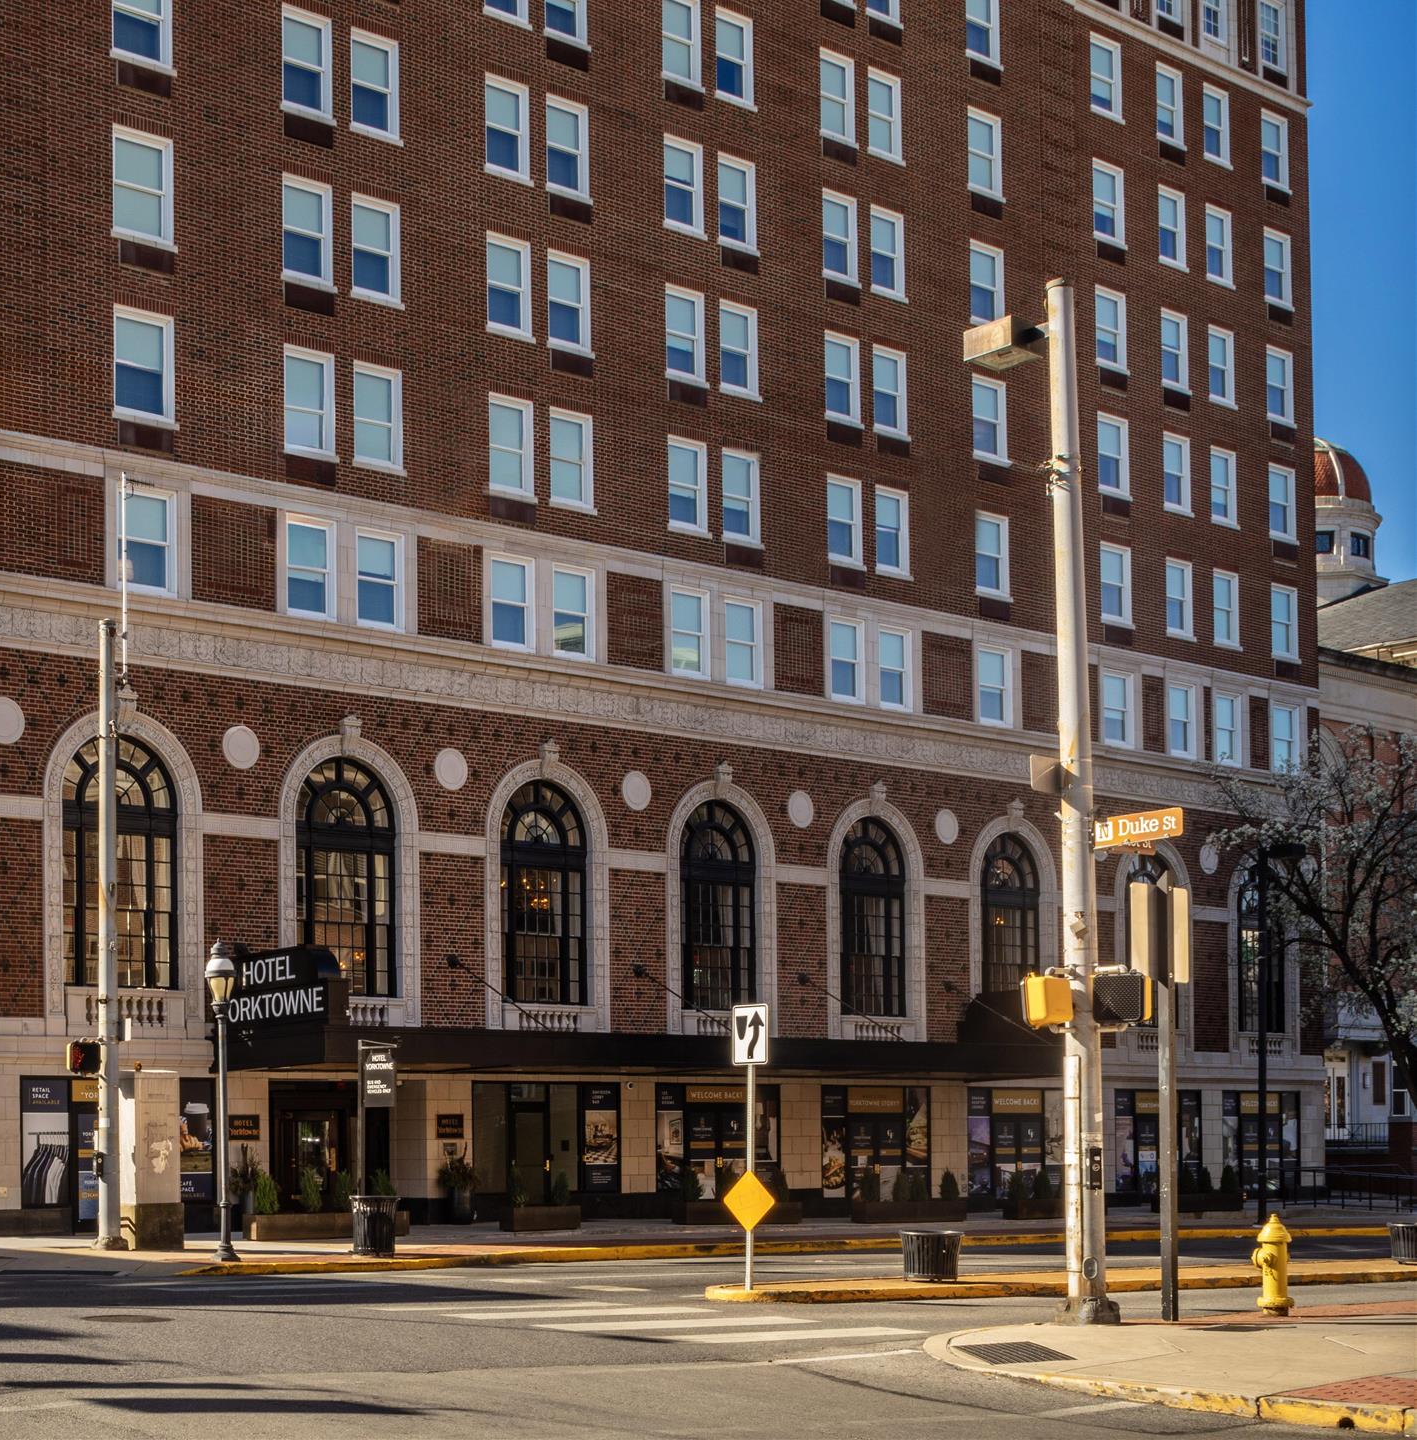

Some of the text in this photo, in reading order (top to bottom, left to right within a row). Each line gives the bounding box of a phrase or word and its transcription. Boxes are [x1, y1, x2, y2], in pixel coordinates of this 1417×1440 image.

[1099, 815, 1177, 839] N Duke St
[242, 955, 296, 987] HOTEL
[228, 986, 324, 1023] ORKTOWNE
[371, 1054, 387, 1062] HOTEL
[365, 1062, 394, 1071] YORKTOWNE
[691, 1091, 743, 1099] WELCOME BACK!
[993, 1098, 1022, 1106] WELCOME
